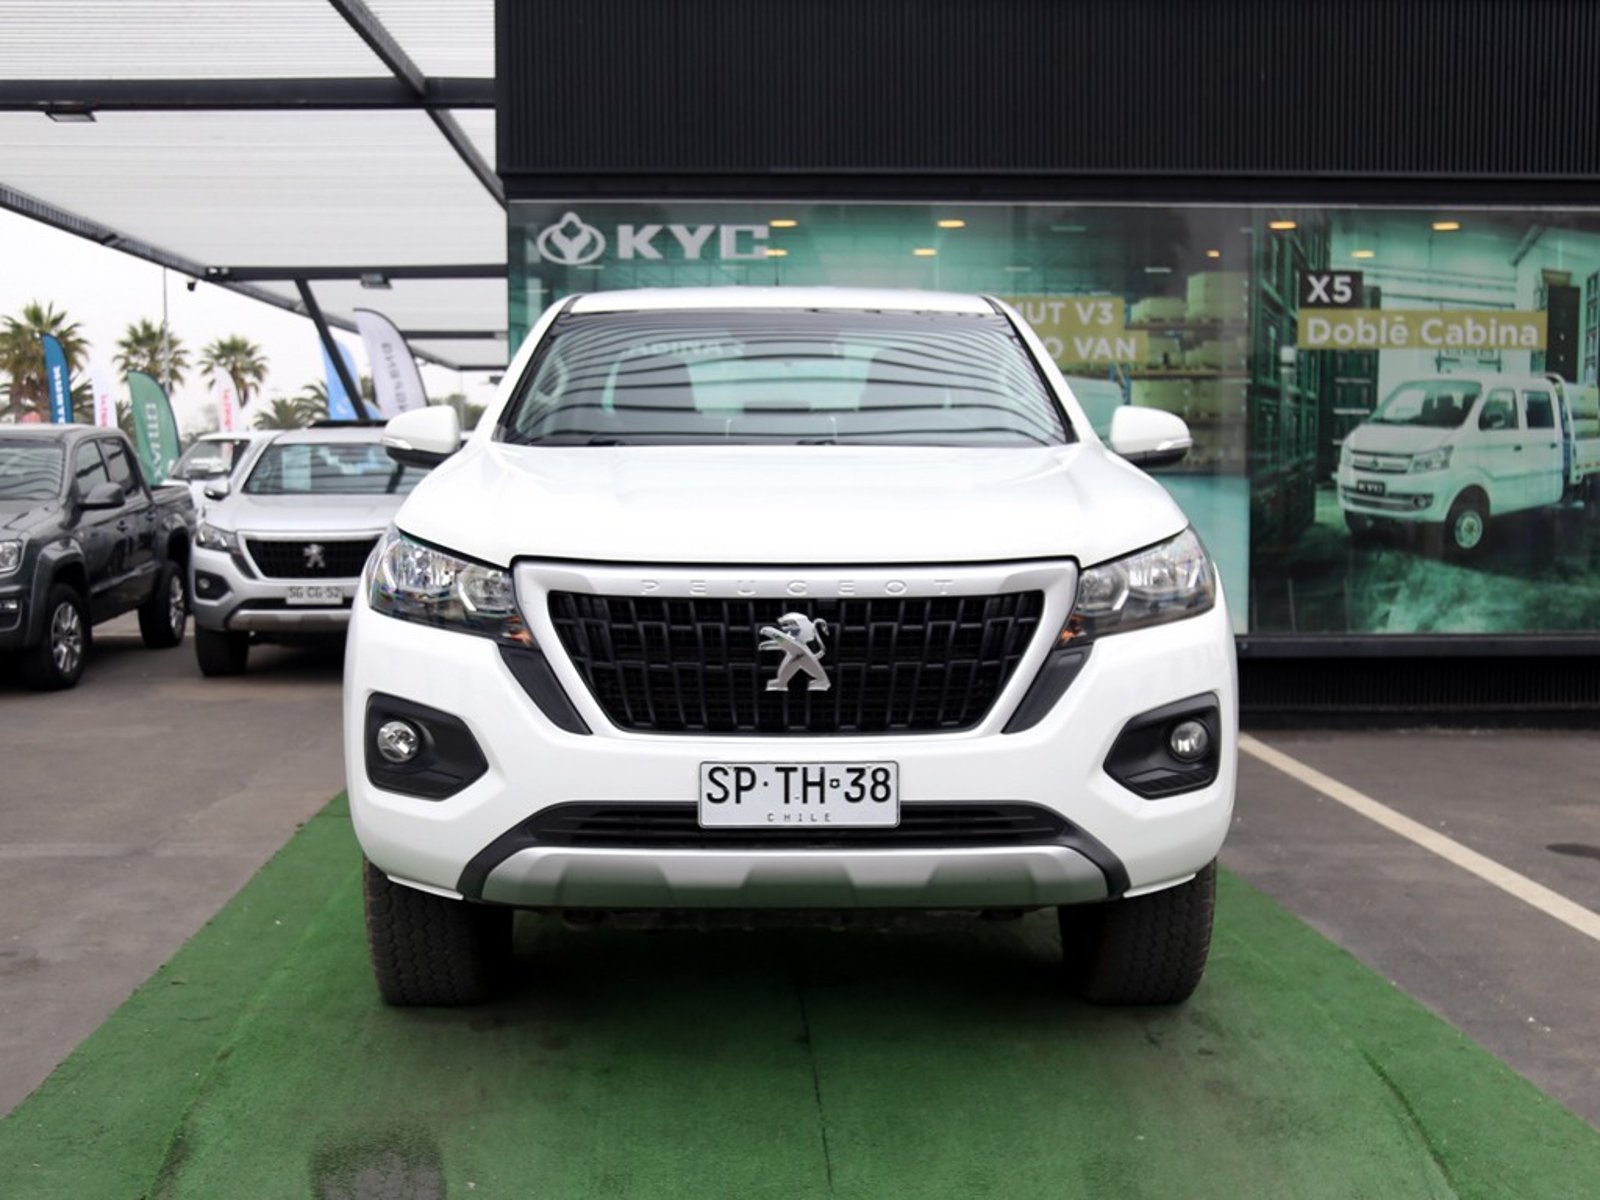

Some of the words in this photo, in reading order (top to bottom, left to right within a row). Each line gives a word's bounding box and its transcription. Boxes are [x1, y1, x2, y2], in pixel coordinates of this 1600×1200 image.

[617, 224, 769, 260] KYC
[1307, 275, 1352, 303] X5
[1075, 302, 1113, 325] V3
[1420, 317, 1538, 346] Cabina
[1074, 336, 1137, 360] VAN
[641, 579, 953, 595] PEUGEOT
[767, 813, 832, 822] CHILE
